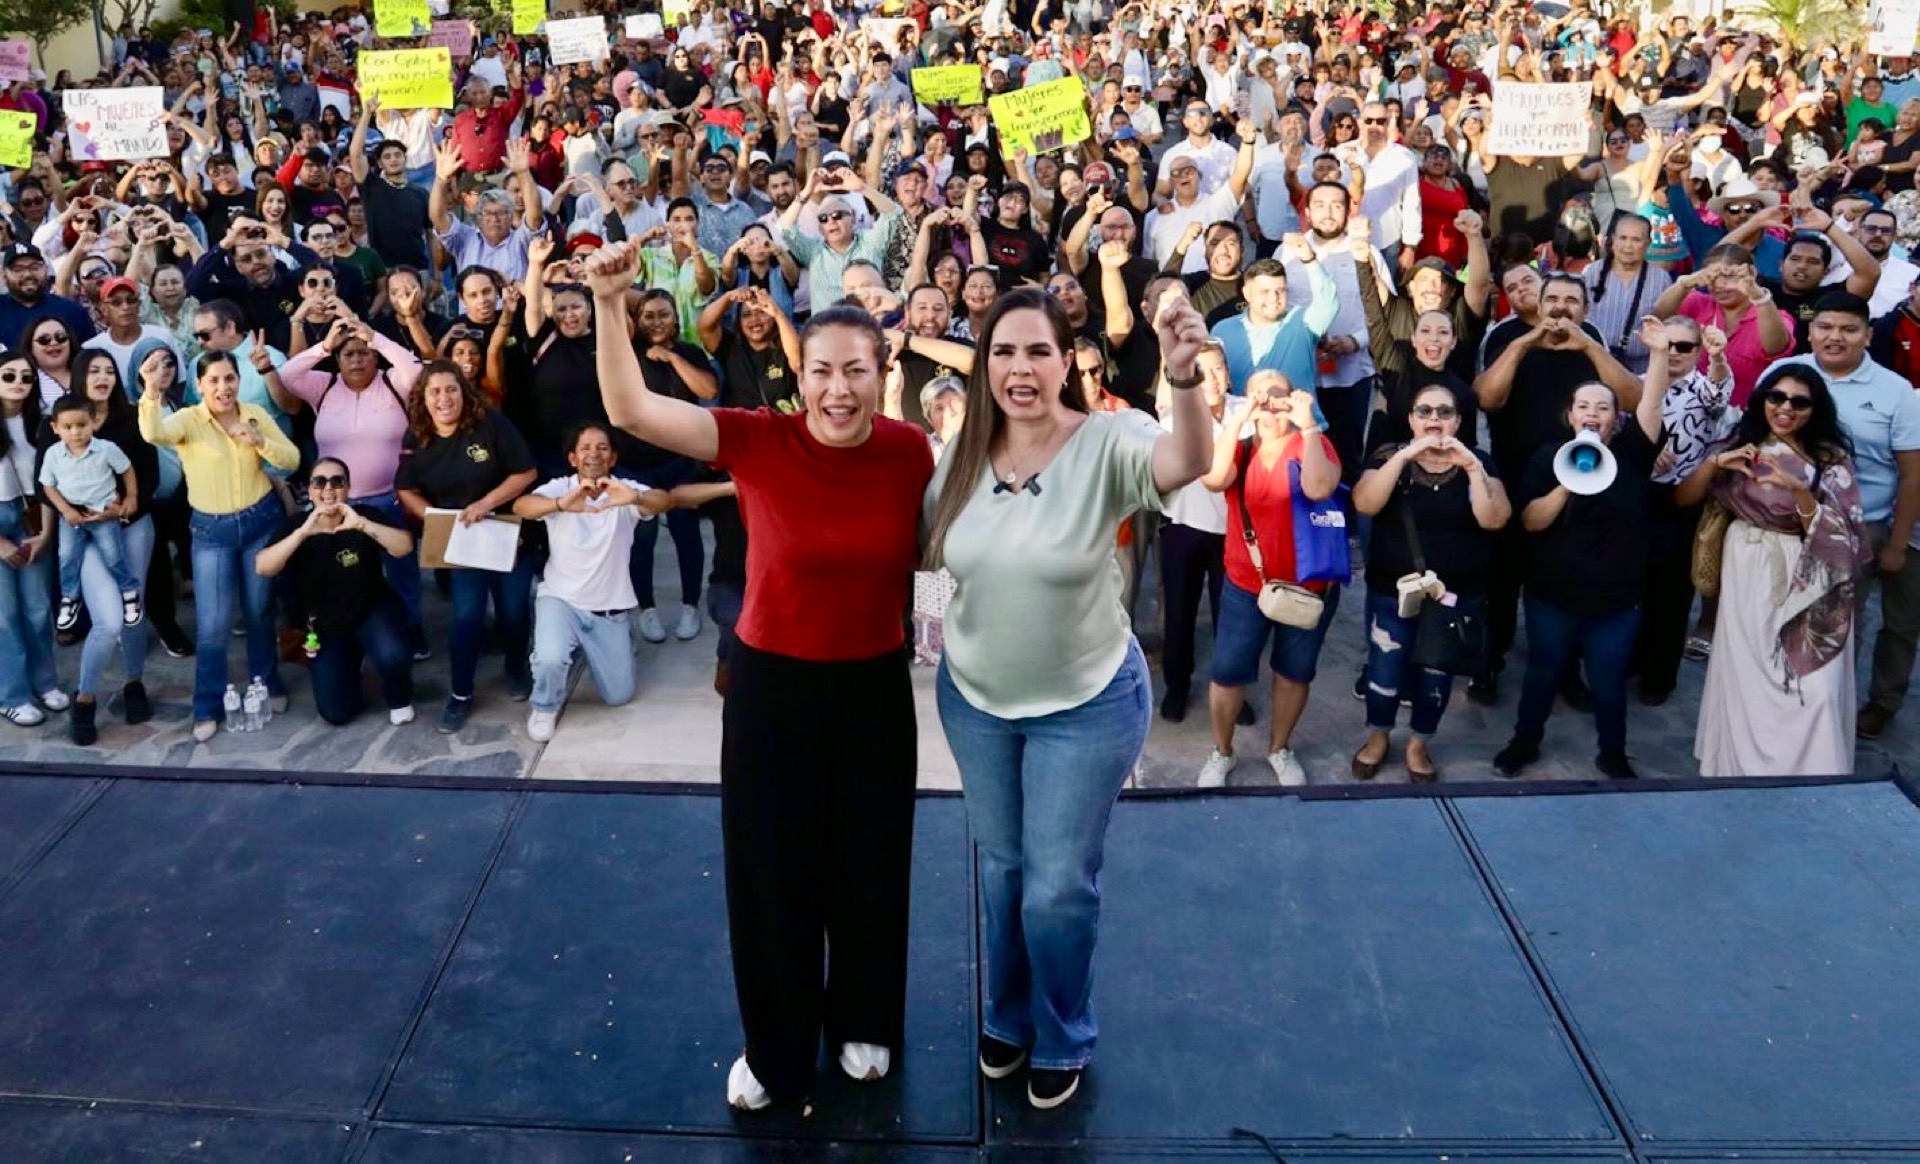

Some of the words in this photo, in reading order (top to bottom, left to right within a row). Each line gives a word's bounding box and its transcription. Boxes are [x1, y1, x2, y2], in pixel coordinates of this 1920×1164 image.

[363, 53, 390, 67] Con
[394, 53, 431, 73] Gaby
[388, 69, 445, 86] mujeres
[67, 91, 98, 108] LAS
[1003, 84, 1064, 110] Mujeres
[1510, 91, 1573, 109] MUJERES
[113, 137, 164, 153] MANDO
